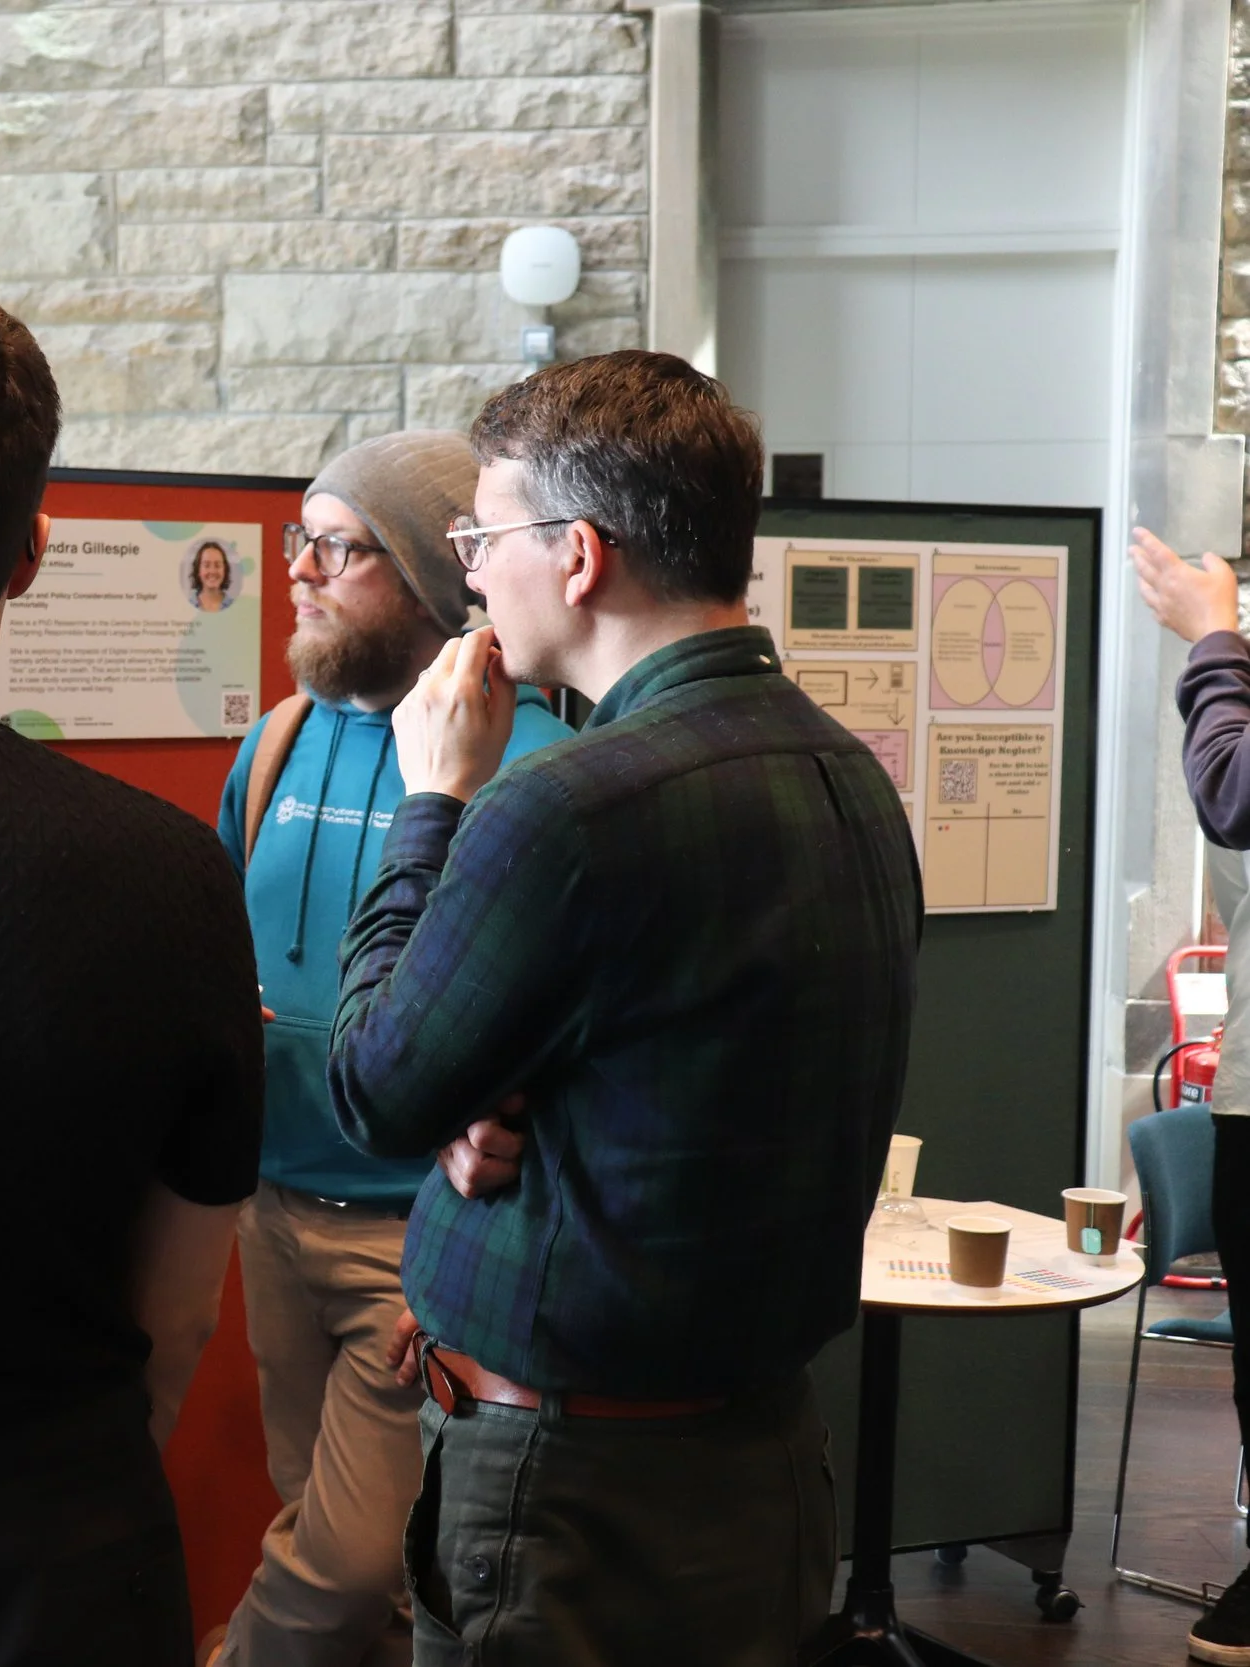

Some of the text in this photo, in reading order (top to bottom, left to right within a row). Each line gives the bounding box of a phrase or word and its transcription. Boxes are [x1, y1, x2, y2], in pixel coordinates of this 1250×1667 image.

[46, 542, 140, 557] ndra Gillespie
[937, 733, 953, 741] Are
[955, 735, 974, 743] you
[976, 733, 1033, 743] Susceptible
[939, 746, 1042, 757] Knowledge Neglect?
